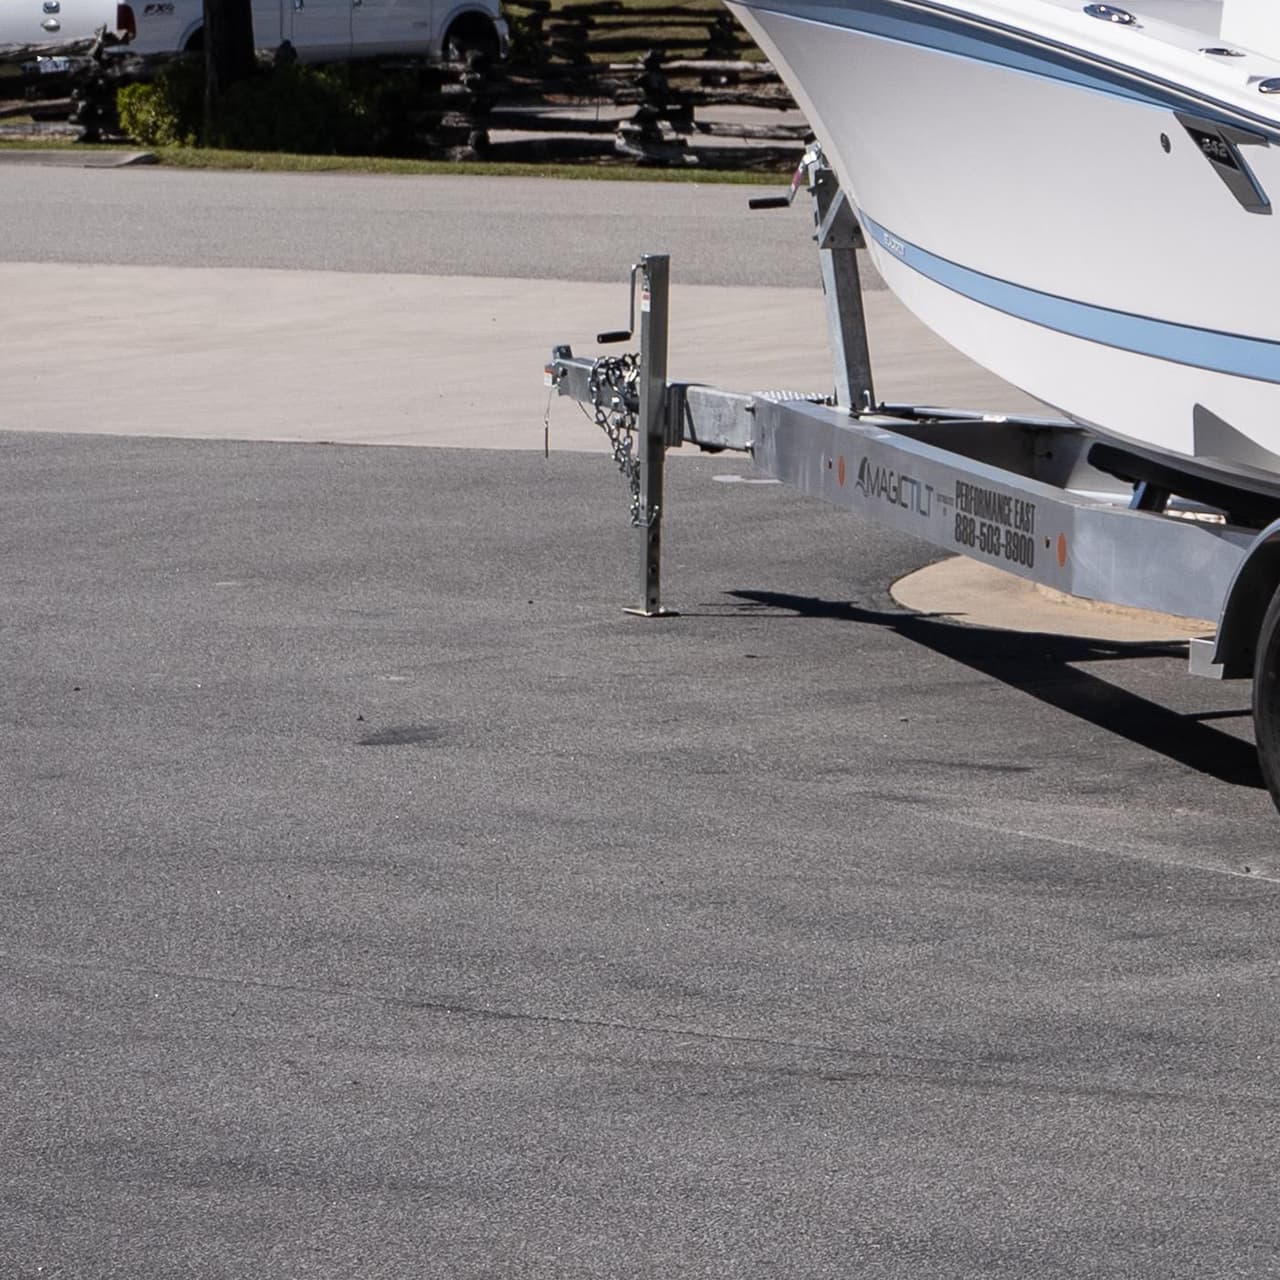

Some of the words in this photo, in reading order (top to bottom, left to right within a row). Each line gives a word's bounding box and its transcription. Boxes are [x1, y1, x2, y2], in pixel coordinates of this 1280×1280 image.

[955, 479, 1013, 528] PERFORMANCE
[1014, 498, 1036, 535] EAST
[954, 512, 1035, 569] 888-503-8900
